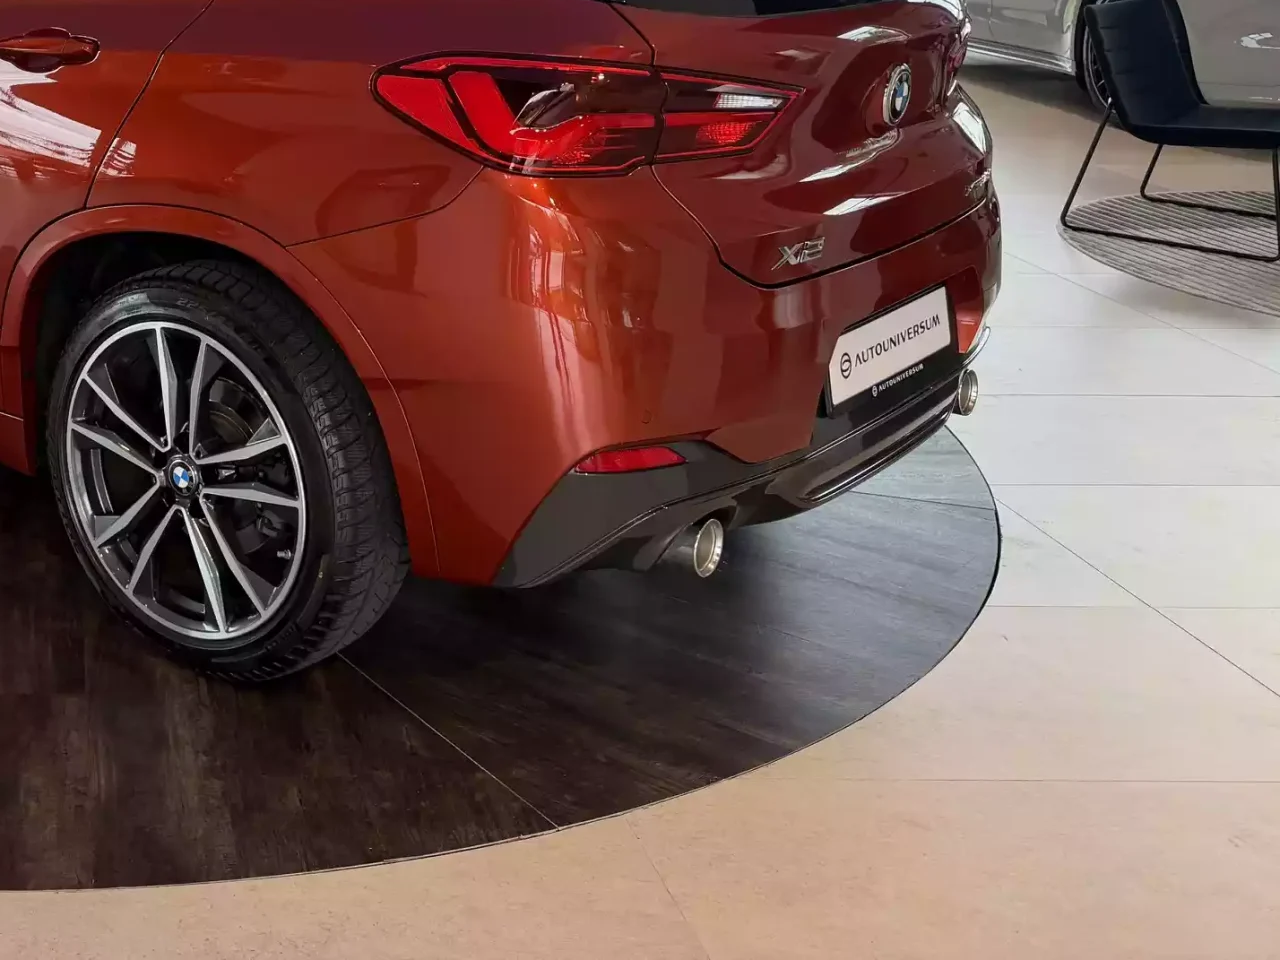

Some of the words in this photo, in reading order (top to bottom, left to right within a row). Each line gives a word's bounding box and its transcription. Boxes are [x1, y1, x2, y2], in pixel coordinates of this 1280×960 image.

[771, 237, 825, 270] X2
[855, 314, 940, 367] AUTOUNIVERSUM
[879, 364, 924, 392] AUTOUNIVERSUM
